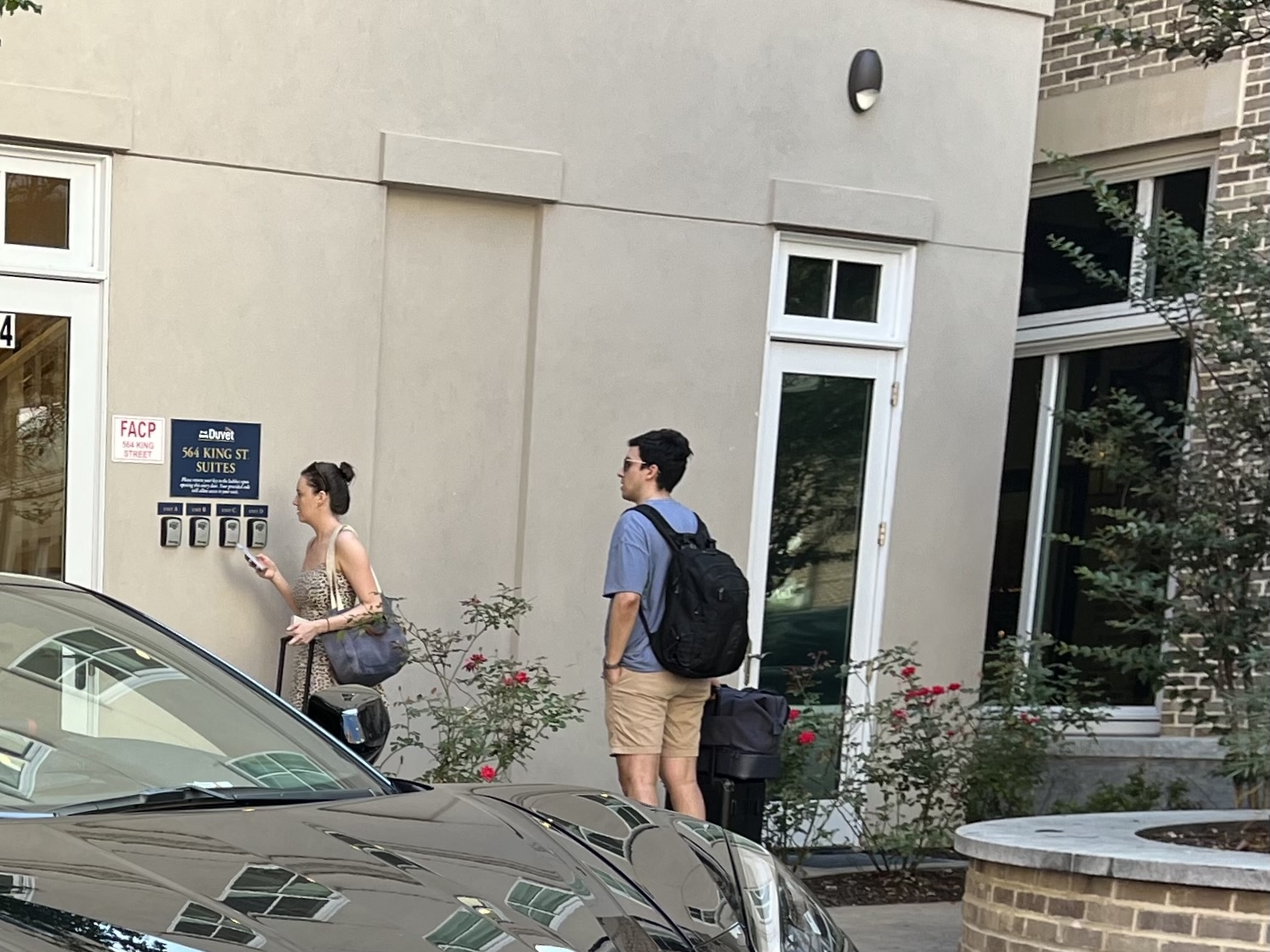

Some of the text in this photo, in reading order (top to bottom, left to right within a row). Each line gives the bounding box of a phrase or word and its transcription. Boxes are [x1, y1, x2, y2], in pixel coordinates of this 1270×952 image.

[120, 420, 156, 438] FACP
[208, 428, 234, 440] Duvet
[122, 440, 155, 450] 564 KING
[123, 450, 152, 459] STREET
[182, 446, 200, 458] 564
[203, 447, 233, 460] KING
[196, 461, 236, 474] SUITES
